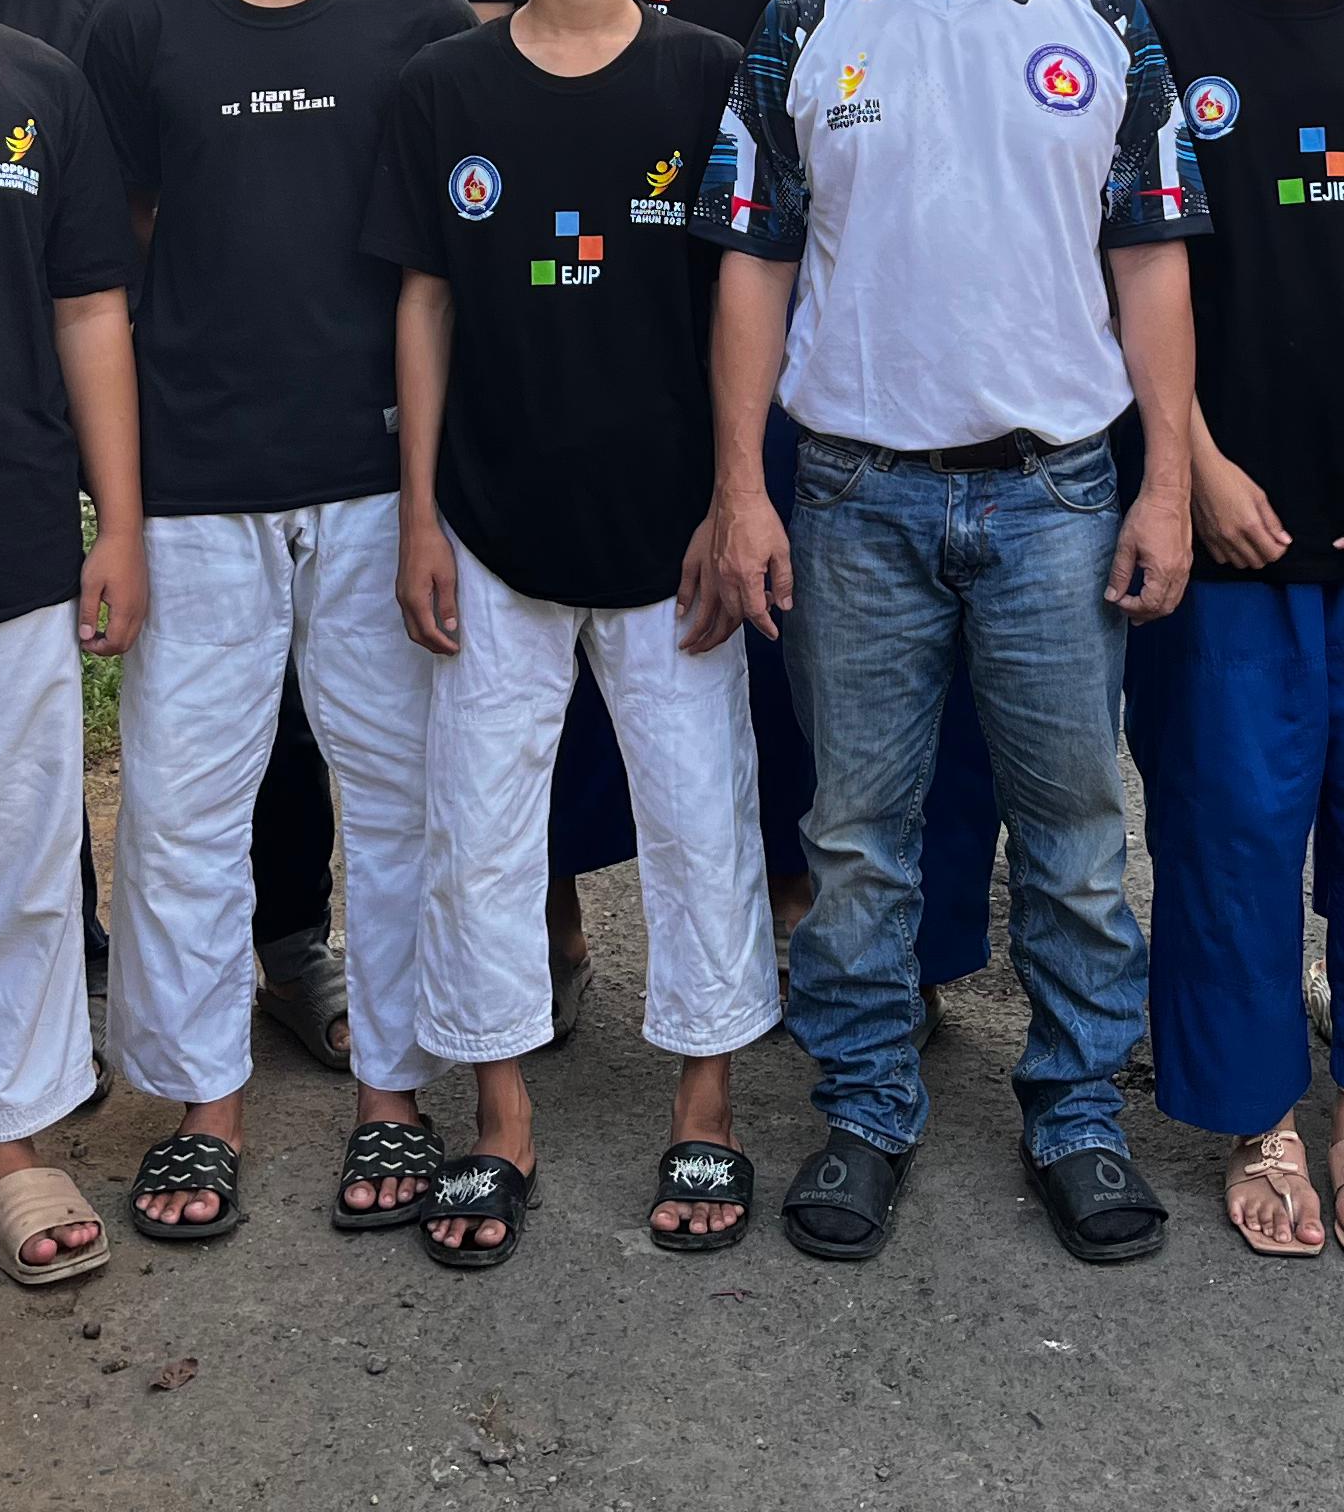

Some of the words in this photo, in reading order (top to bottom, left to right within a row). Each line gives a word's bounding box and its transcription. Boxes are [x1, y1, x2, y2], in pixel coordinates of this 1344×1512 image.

[250, 102, 283, 114] the
[293, 96, 336, 111] wall
[864, 98, 881, 109] XII
[856, 113, 882, 124] 2024
[630, 198, 671, 211] POPDA
[630, 214, 662, 224] TAHUN
[561, 265, 601, 285] EJIP
